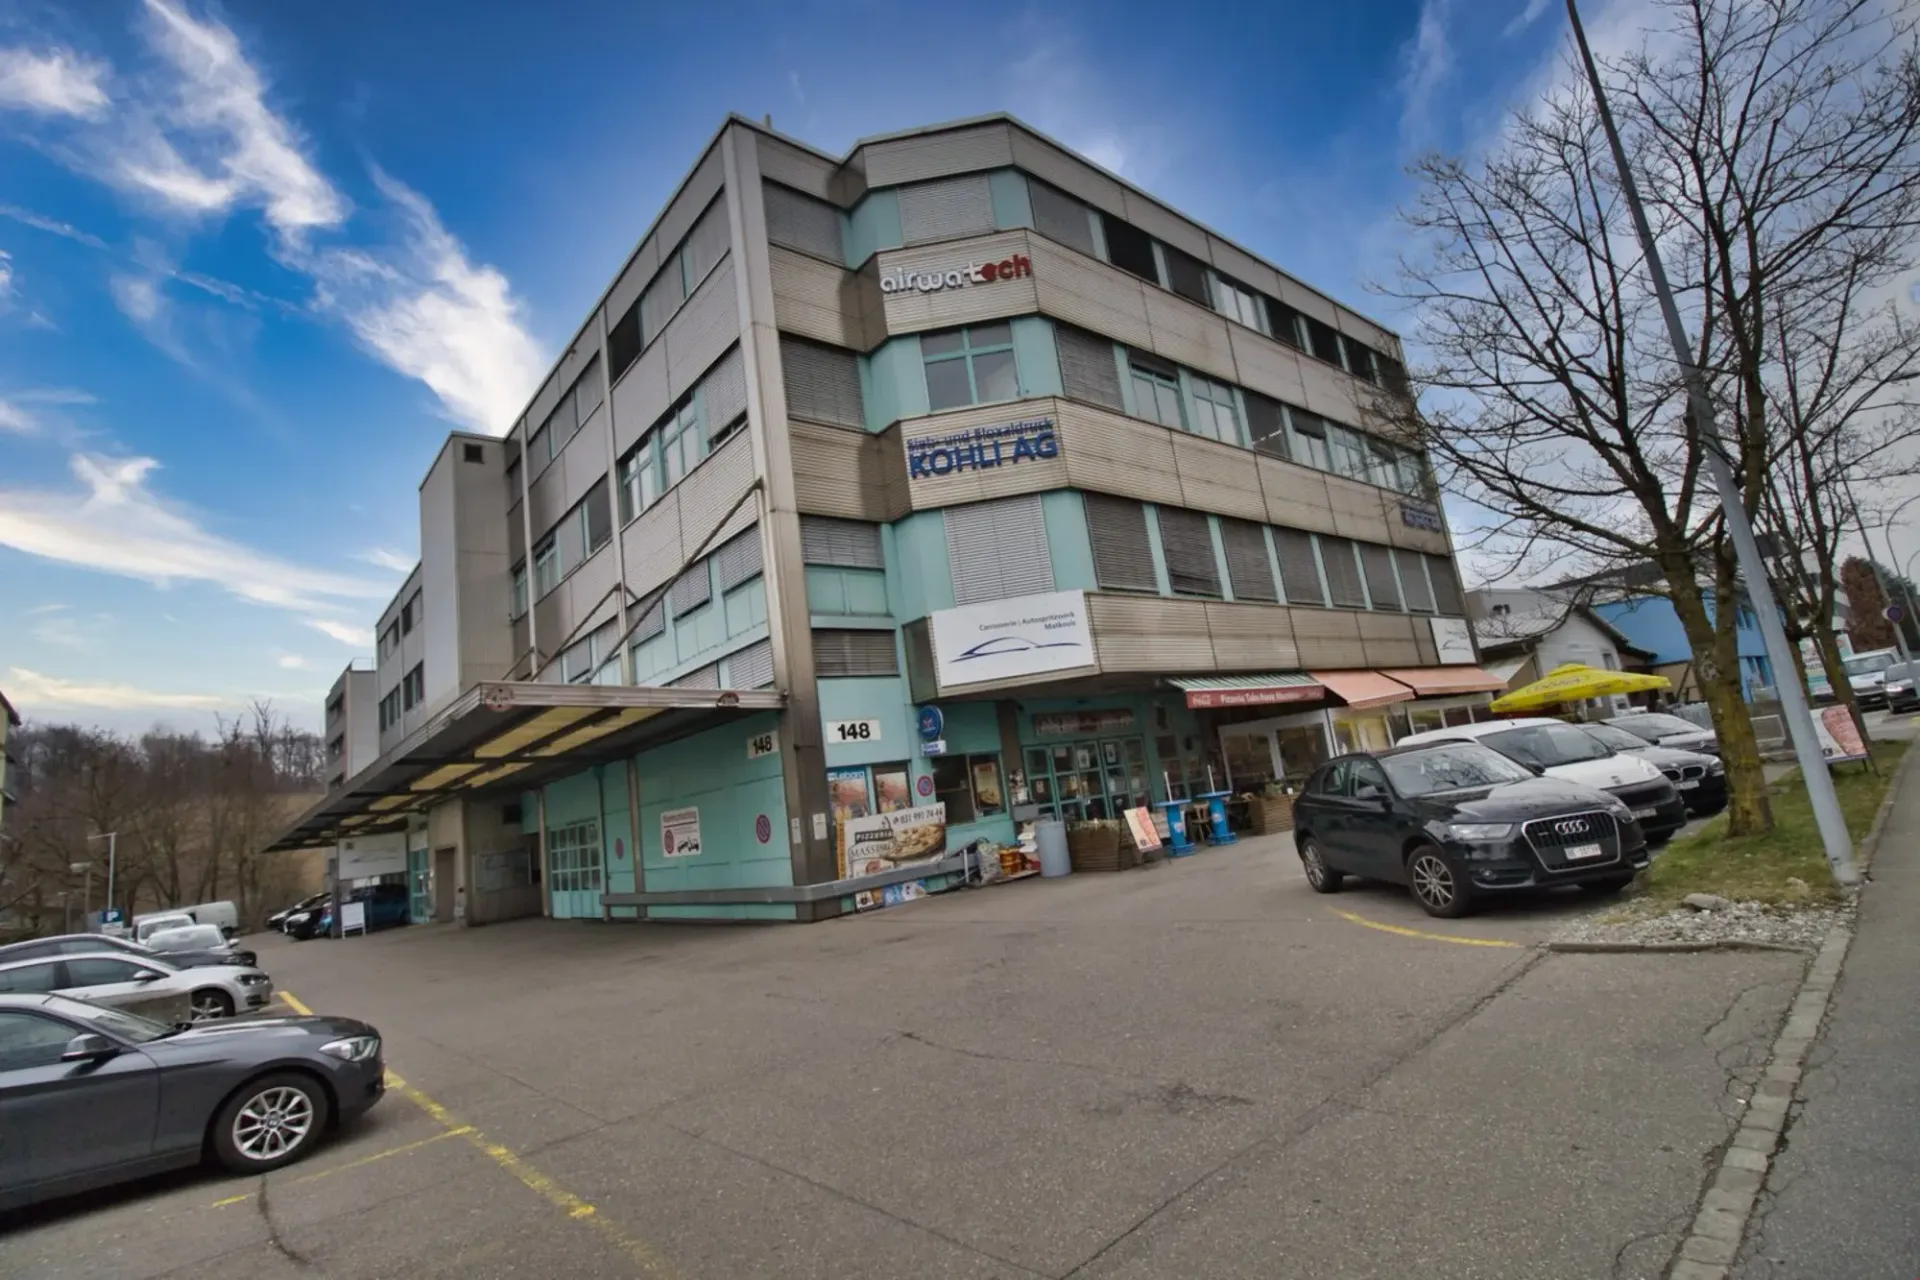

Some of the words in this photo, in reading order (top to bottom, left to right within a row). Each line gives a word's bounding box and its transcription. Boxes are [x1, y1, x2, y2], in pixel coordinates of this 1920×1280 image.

[909, 439, 1002, 479] KOHLI
[1012, 430, 1059, 464] AG
[837, 722, 871, 741] 148
[752, 734, 773, 755] 148
[855, 829, 893, 842] PIZZERIA
[106, 910, 119, 922] P
